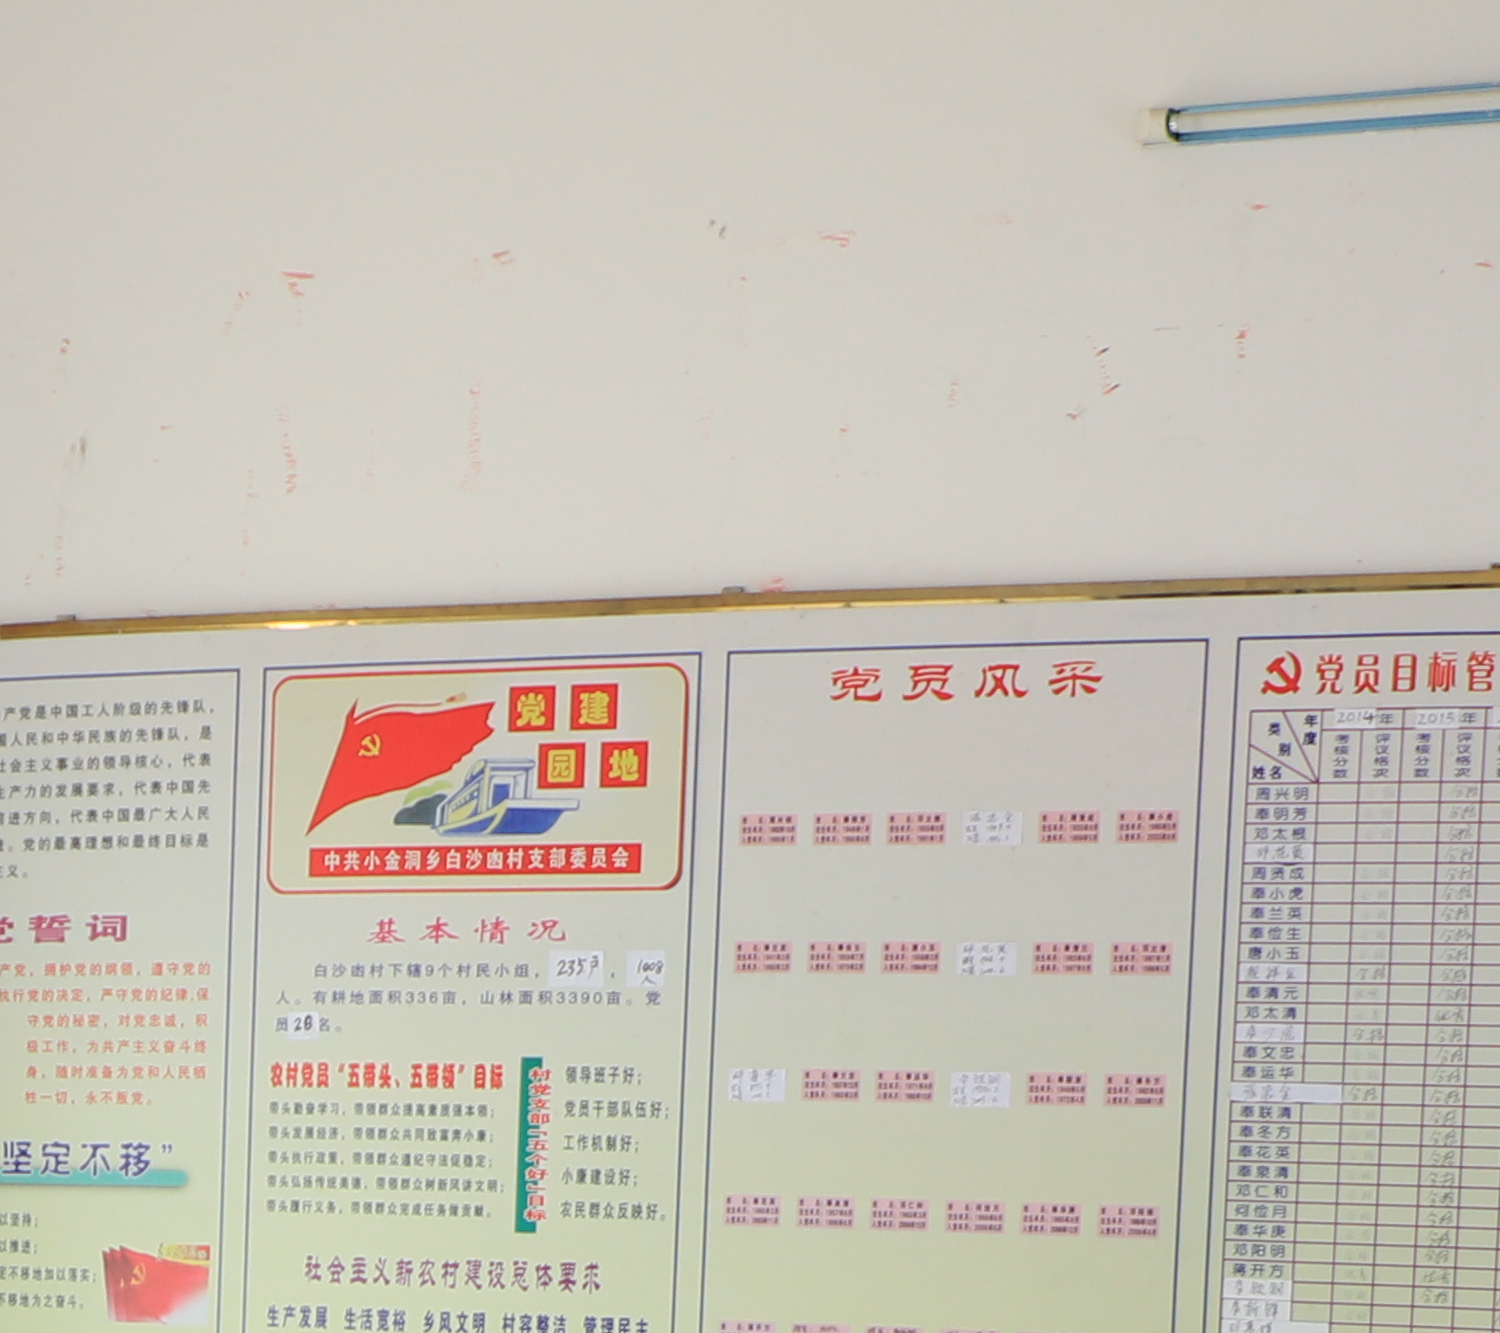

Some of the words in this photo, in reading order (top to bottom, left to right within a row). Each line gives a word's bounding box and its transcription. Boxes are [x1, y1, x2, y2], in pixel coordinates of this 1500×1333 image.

[828, 660, 1104, 702] 党员风采
[515, 689, 611, 728] 党建
[546, 747, 641, 784] 园地
[1251, 765, 1283, 781] 姓名
[366, 916, 568, 945] 基本情况
[565, 1065, 643, 1085] 领导班子好；
[563, 1100, 670, 1121] 党员干部队伍好；
[562, 1134, 641, 1154] 工作机制好；
[560, 1167, 639, 1188] 小康建设好；
[304, 1254, 602, 1294] 社会主义新农村建设总体要求
[266, 1304, 329, 1330] 生产发展
[343, 1306, 407, 1333] 生活宽裕
